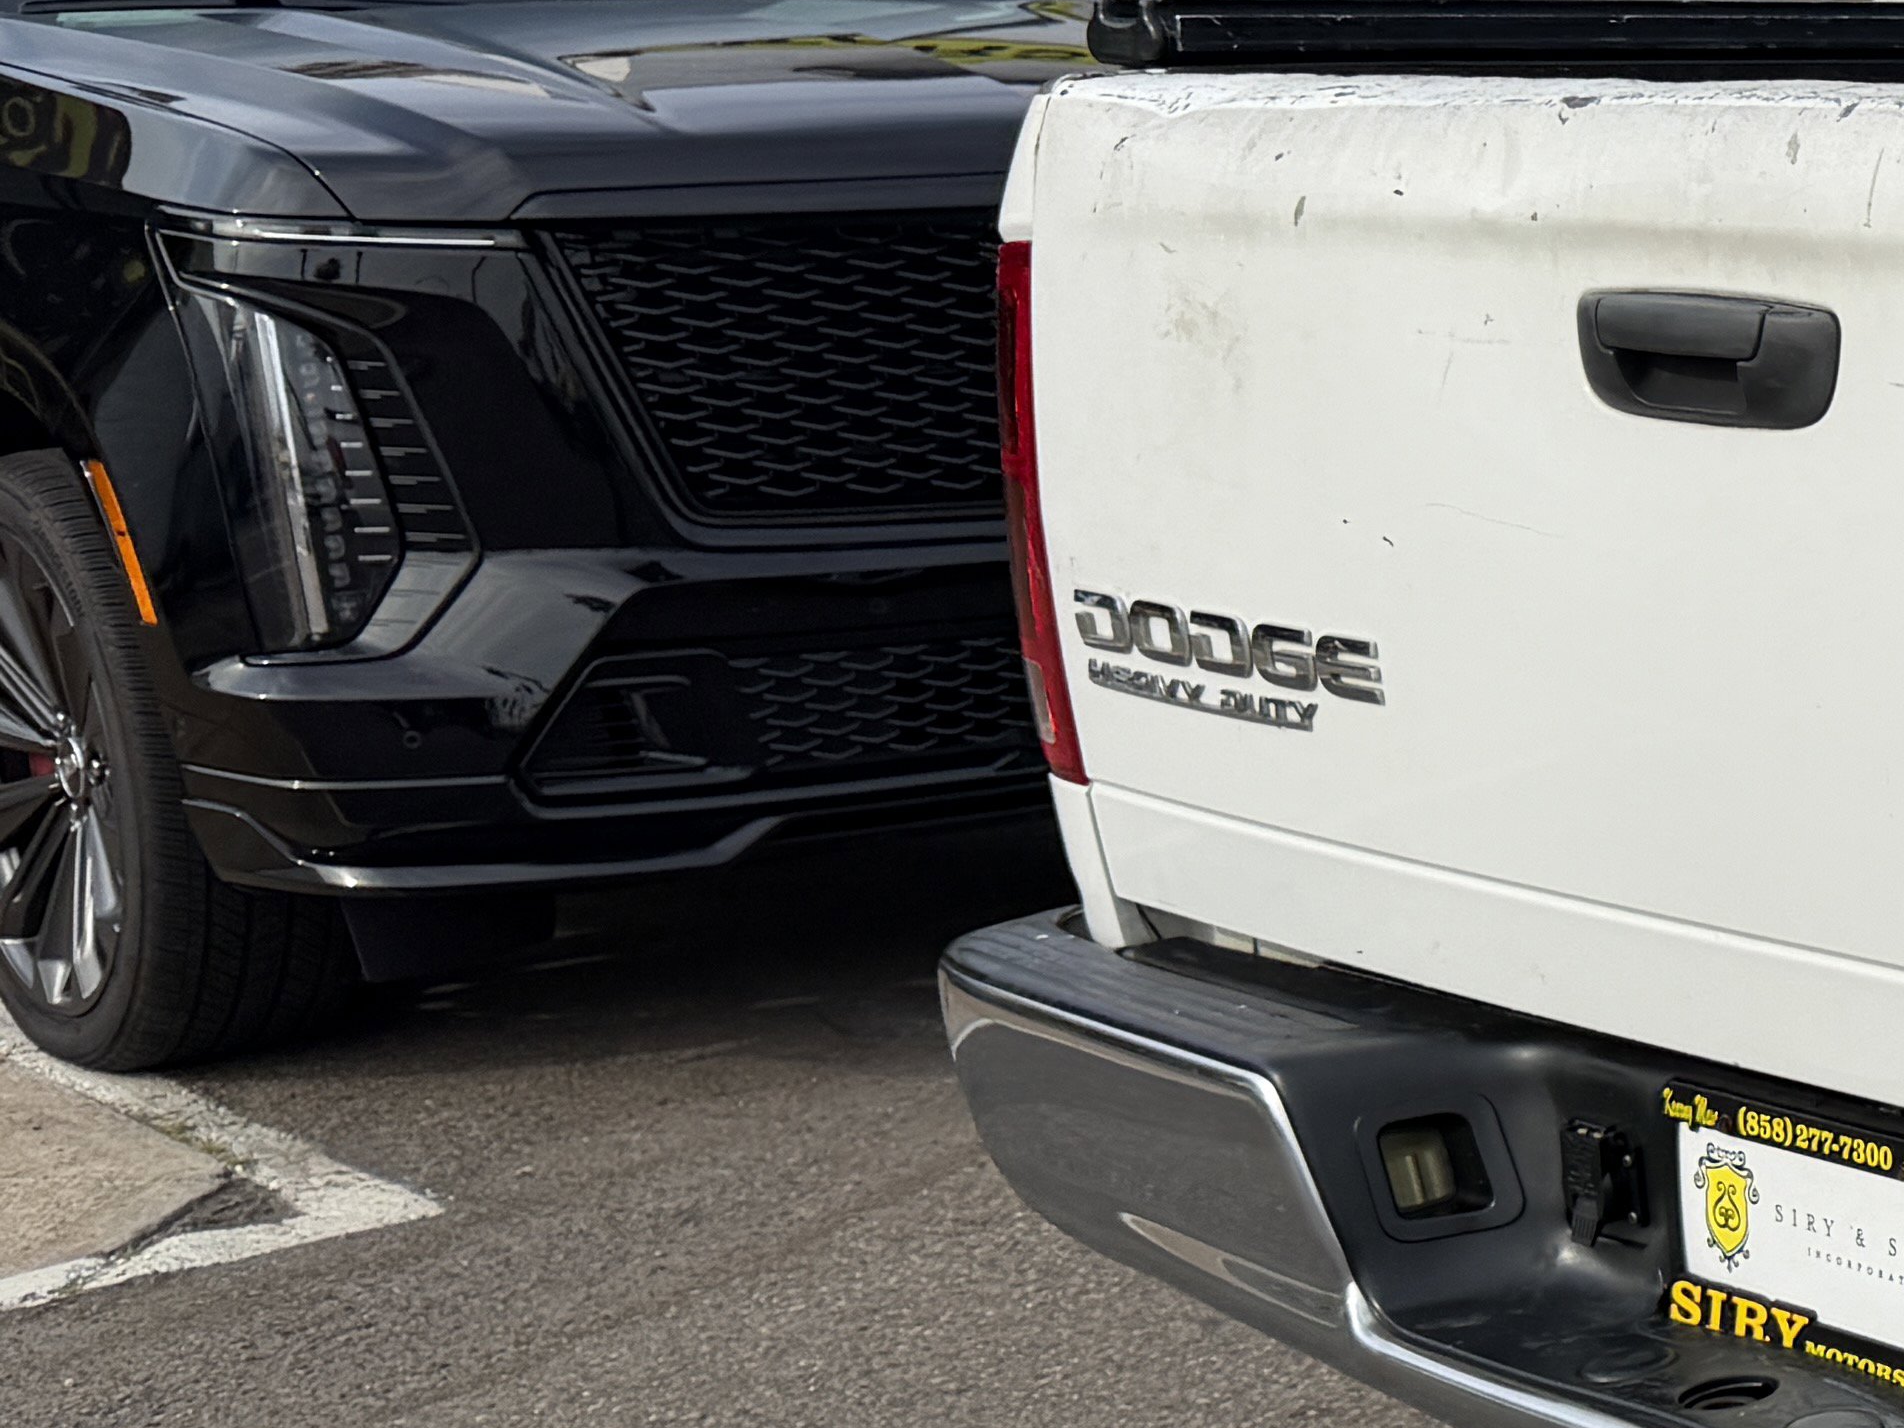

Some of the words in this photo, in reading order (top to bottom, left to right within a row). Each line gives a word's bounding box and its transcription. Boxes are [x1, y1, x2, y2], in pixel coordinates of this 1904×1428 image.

[1074, 589, 1386, 706] DODGE
[1088, 657, 1206, 704] HEAVY
[1220, 688, 1319, 725] DUTY
[1737, 1105, 1793, 1147] (858)
[1795, 1124, 1893, 1171] 277-7300
[1774, 1204, 1835, 1237] SIRY
[1855, 1228, 1866, 1248] &
[1669, 1280, 1810, 1349] SIRY
